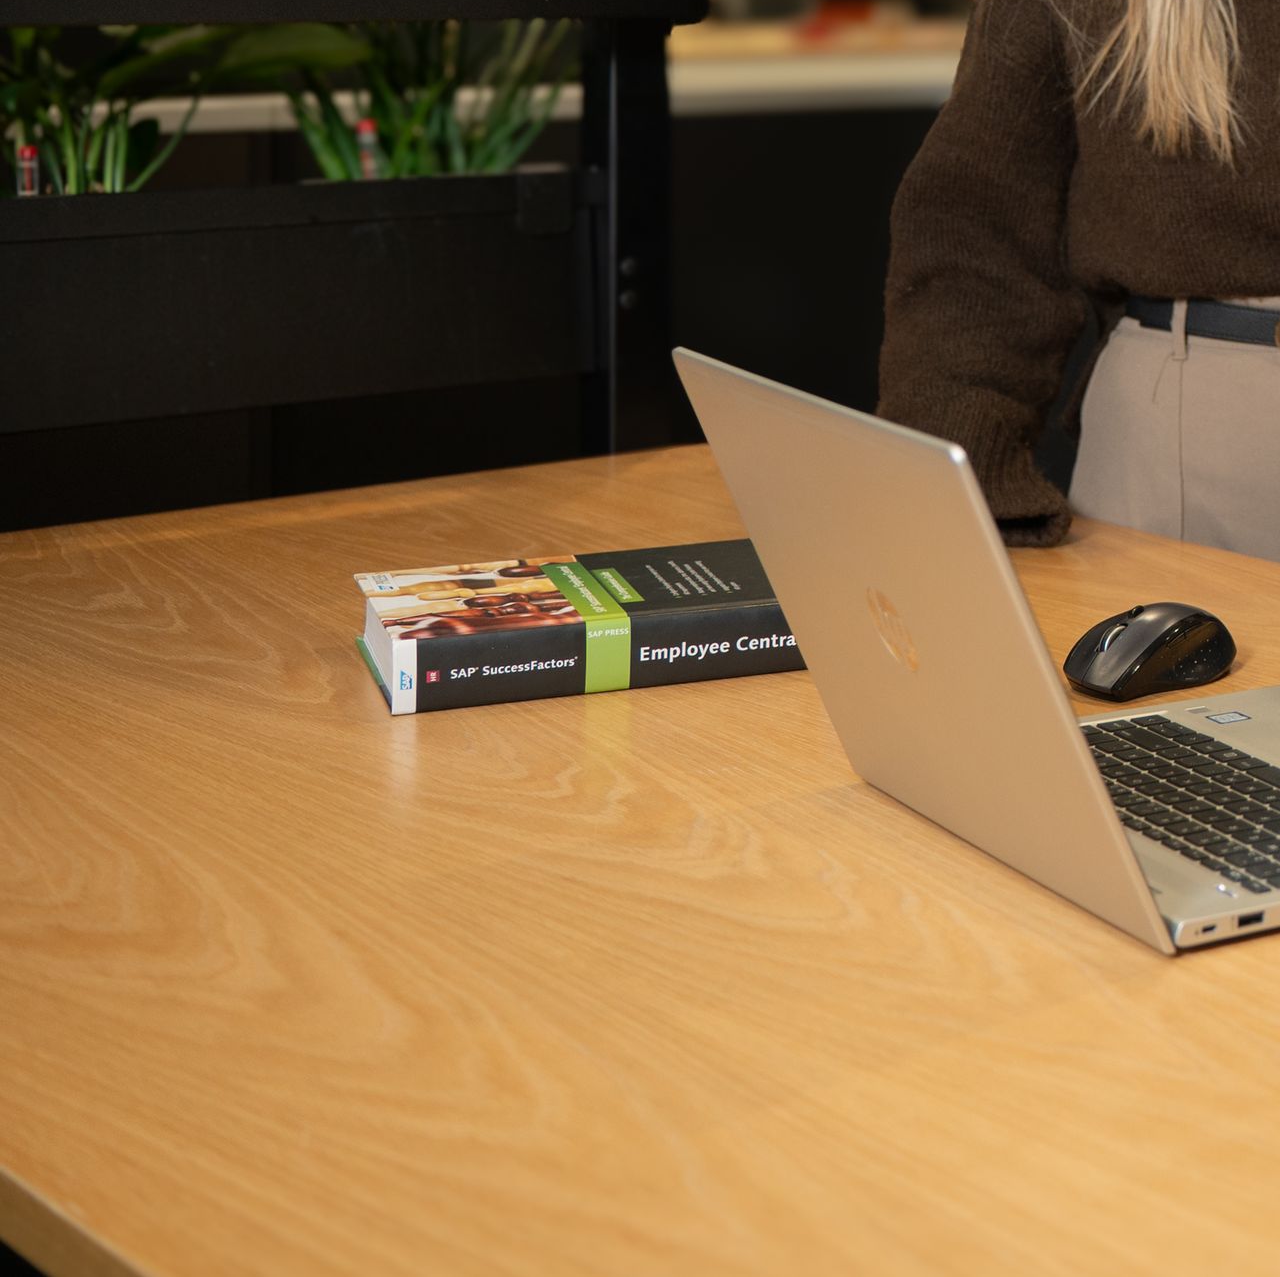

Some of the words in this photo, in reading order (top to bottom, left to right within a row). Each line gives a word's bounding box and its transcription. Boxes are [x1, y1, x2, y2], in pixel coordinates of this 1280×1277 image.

[587, 630, 603, 639] SAP
[605, 627, 629, 637] PRESS
[640, 641, 730, 663] Employee
[736, 633, 797, 652] Centra
